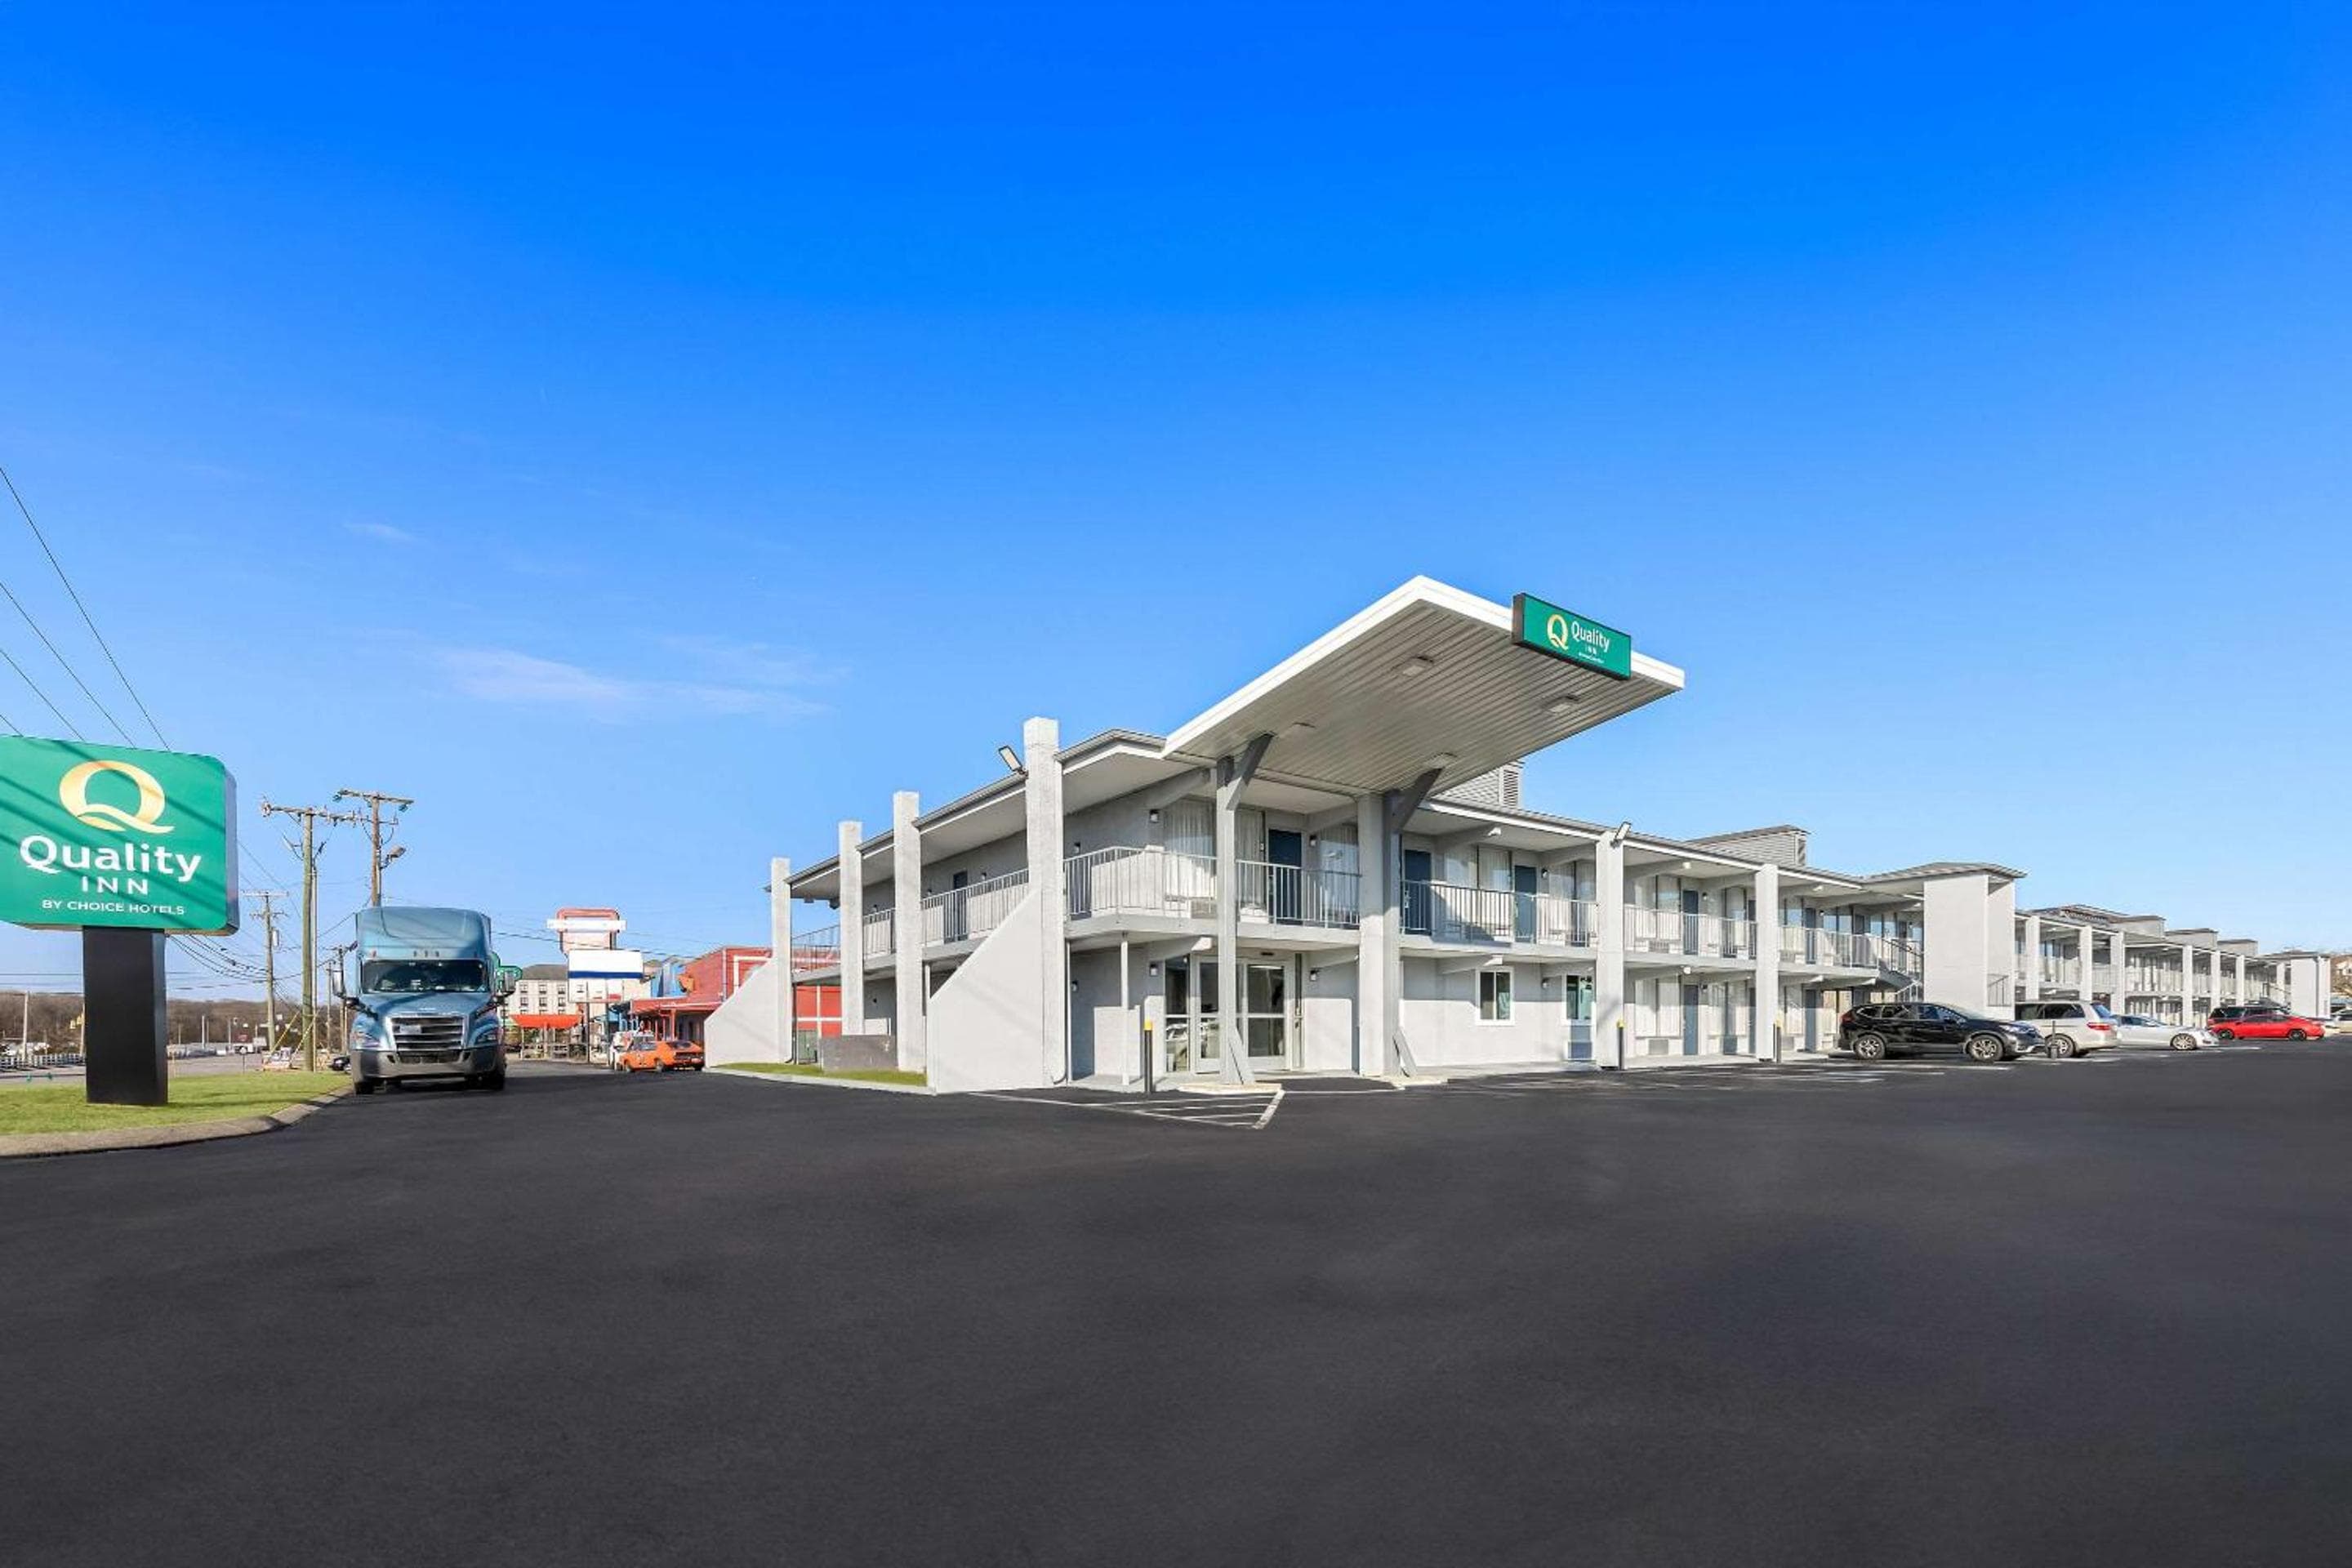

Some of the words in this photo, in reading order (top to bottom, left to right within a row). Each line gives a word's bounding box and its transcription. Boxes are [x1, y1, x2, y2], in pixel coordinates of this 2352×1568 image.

[1547, 614, 1568, 650] Q
[1571, 621, 1610, 653] Quality
[59, 760, 175, 834] Q
[20, 835, 202, 882] Quality
[82, 876, 149, 895] INN
[42, 899, 63, 909] BY
[67, 901, 124, 912] CHOICE
[129, 903, 185, 915] HOTELS
